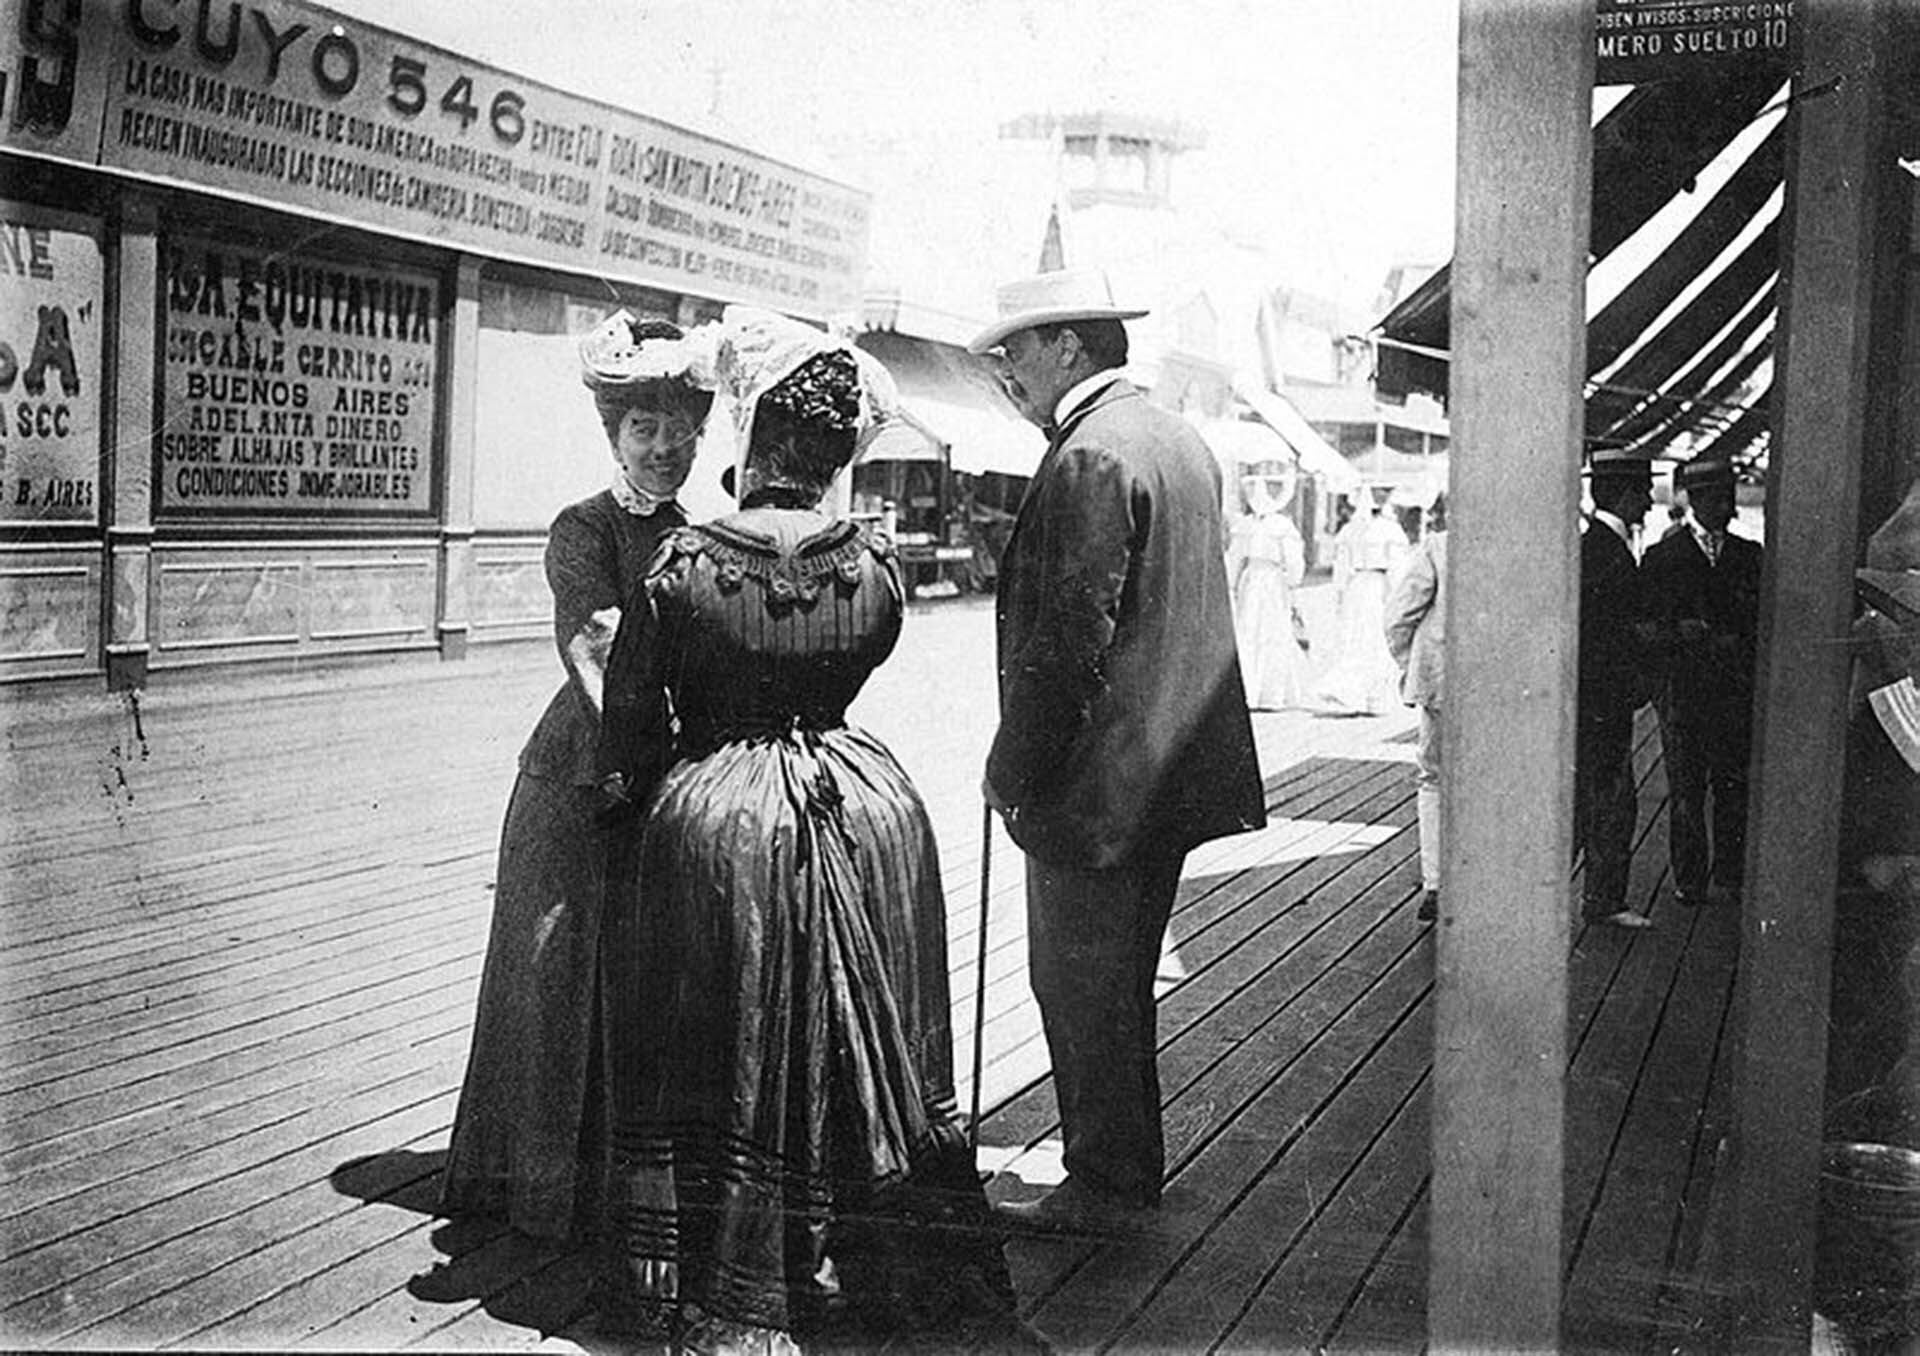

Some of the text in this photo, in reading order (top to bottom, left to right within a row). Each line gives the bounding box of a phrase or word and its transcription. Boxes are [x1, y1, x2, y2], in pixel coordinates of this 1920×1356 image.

[1598, 18, 1787, 57] MERO SUELTO 10
[125, 0, 361, 98] CUYO
[386, 54, 526, 147] 546
[125, 57, 147, 97] LA
[227, 85, 322, 139] IMPORTANTE
[118, 108, 182, 157] RECIEN
[235, 257, 431, 345] EQUITATIVA
[199, 329, 285, 375] CALLE
[297, 344, 392, 384] CERRITO
[187, 372, 410, 416] BUENOS AIRES
[189, 405, 402, 442] ADELANTA DINERO
[163, 433, 418, 472] SOBRE ALHAJAS Y BRILLANTES
[42, 479, 93, 507] AIRES
[176, 465, 411, 500] CONDICIONES INMEJORABLES
